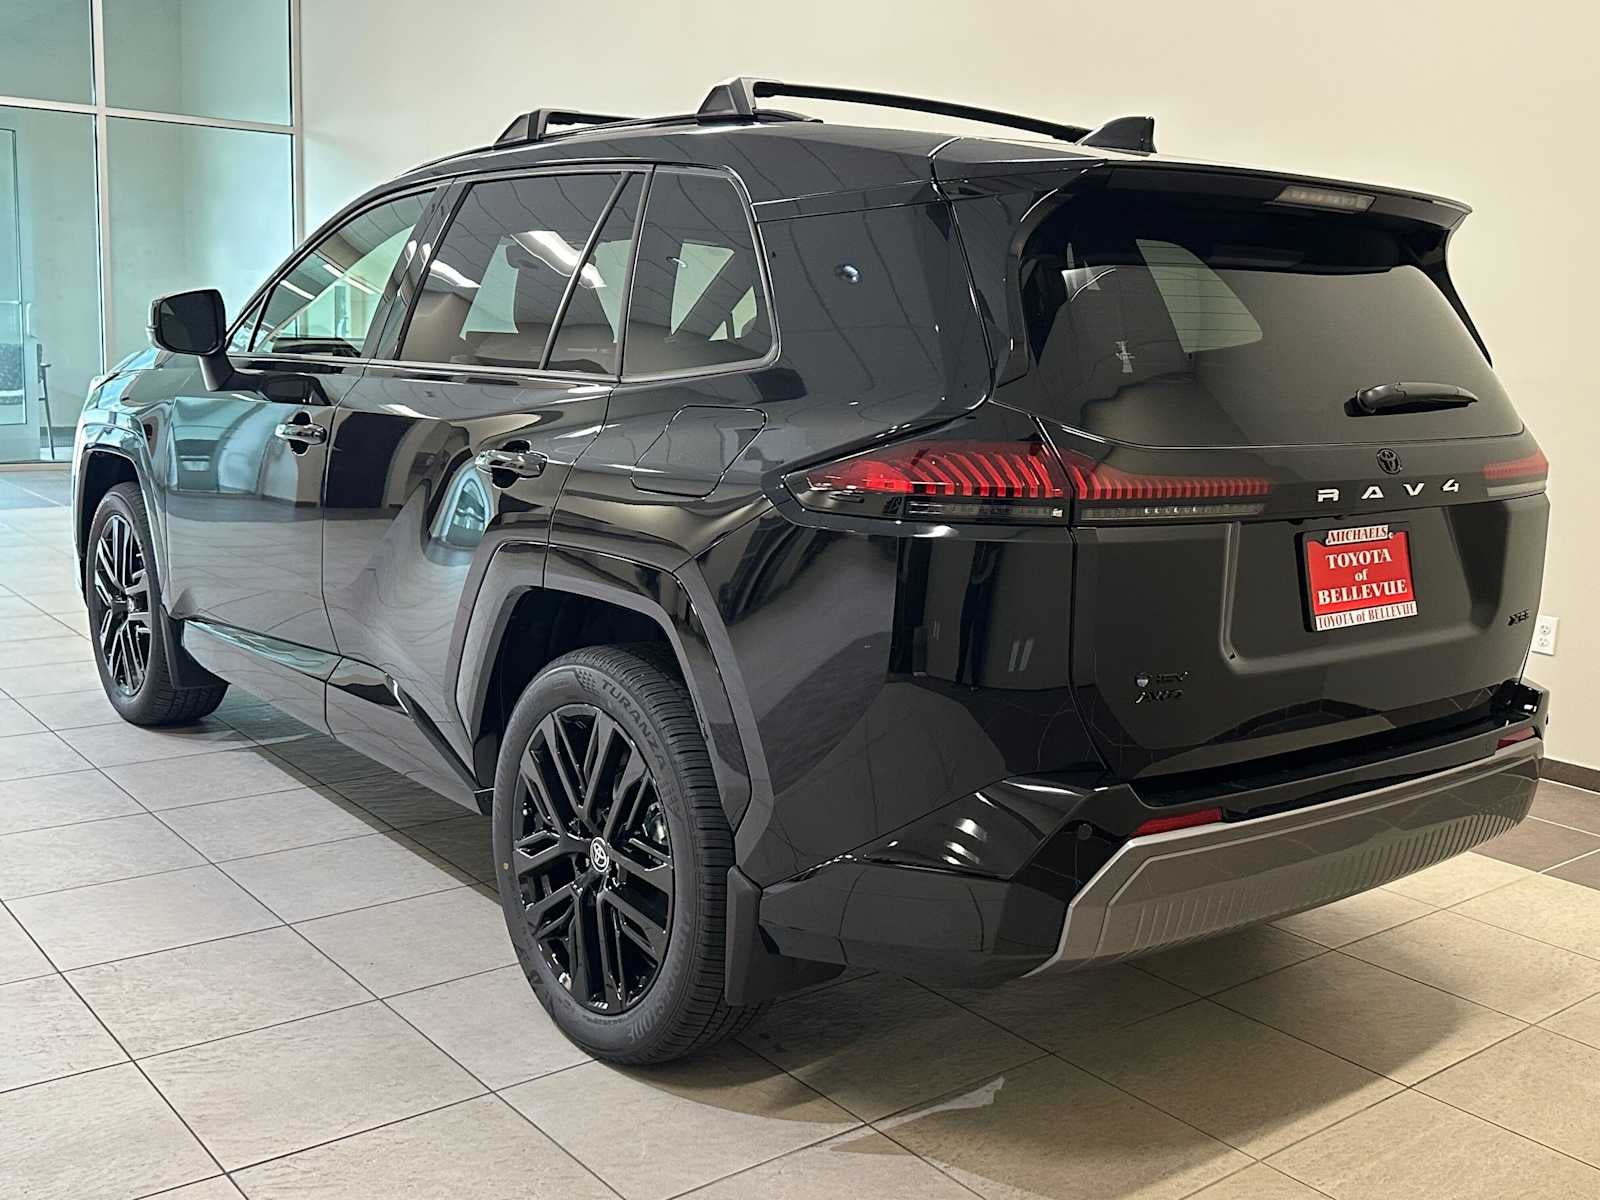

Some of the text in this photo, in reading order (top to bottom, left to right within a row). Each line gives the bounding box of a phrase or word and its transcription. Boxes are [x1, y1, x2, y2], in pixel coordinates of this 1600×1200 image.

[1316, 478, 1460, 502] RAV4
[1327, 526, 1388, 544] MICHAELS
[1325, 548, 1392, 569] TOYOTA
[1354, 568, 1369, 582] of
[1317, 579, 1408, 605] BELLEVUE
[1317, 603, 1415, 629] TOYOTA of BELLEVUE
[602, 679, 666, 771] TURANZA
